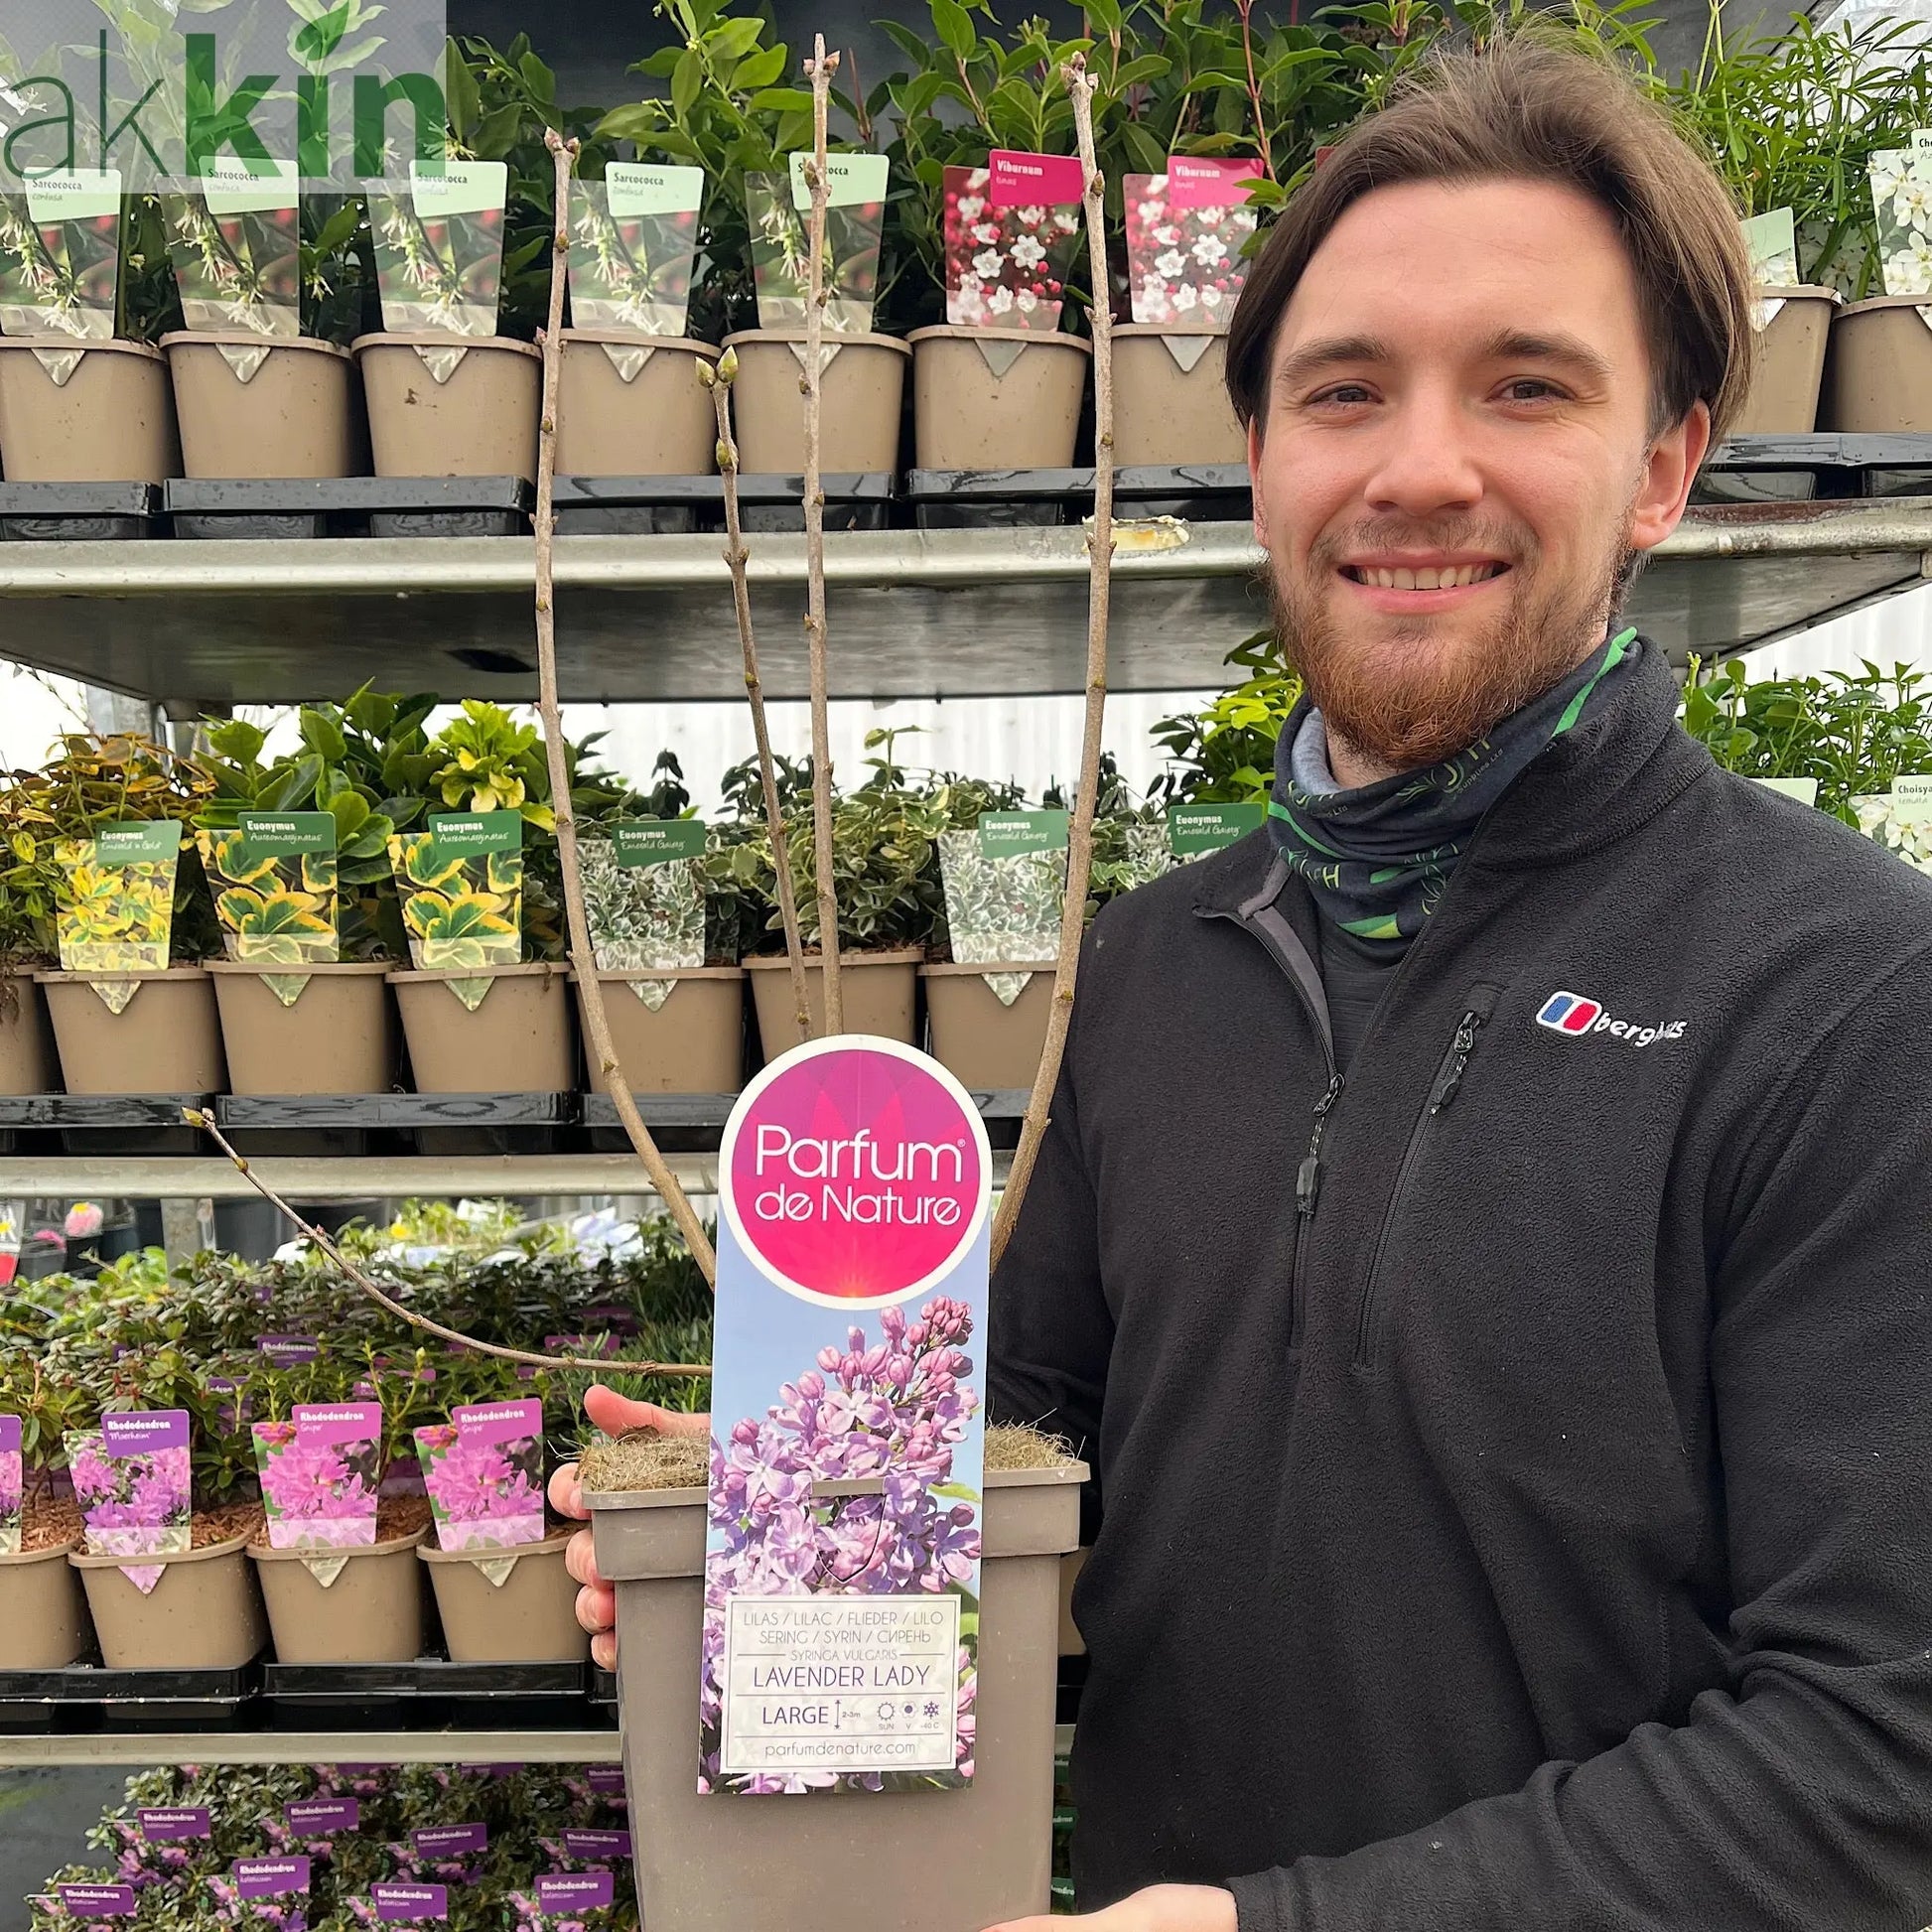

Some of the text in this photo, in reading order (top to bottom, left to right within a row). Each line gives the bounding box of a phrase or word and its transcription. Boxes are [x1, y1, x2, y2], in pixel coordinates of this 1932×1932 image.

[996, 159, 1043, 176] Viburnum
[1174, 165, 1221, 178] Viburnum
[207, 168, 259, 182] Sarcococca
[418, 172, 468, 184] Sarcococca
[614, 172, 664, 186] Sarcococca
[32, 179, 82, 191] Sarcococca
[246, 820, 296, 833] Euonymus
[985, 820, 1032, 832] Euonymus
[1175, 814, 1223, 826] Euonymus
[436, 822, 483, 834] Euonymus
[619, 830, 666, 841] Euonymus
[755, 1182, 961, 1226] de Nature
[300, 1411, 364, 1422] Rhododendron
[461, 1409, 525, 1424] Rhododendron
[107, 1419, 171, 1432] Rhododendron
[744, 1611, 779, 1626] LILAS
[794, 1611, 833, 1626] LILAC
[848, 1611, 897, 1626] FLIEDER
[913, 1610, 944, 1625] LILO
[759, 1630, 808, 1644] SERING
[823, 1630, 862, 1644] SYRIN
[791, 1649, 897, 1662] SYRINGA VULGARIS
[754, 1665, 930, 1688] LAVENDER LADY
[762, 1706, 829, 1725] LARGE
[765, 1740, 915, 1759] parfumdenature.com
[239, 1863, 296, 1874] Rhododendron
